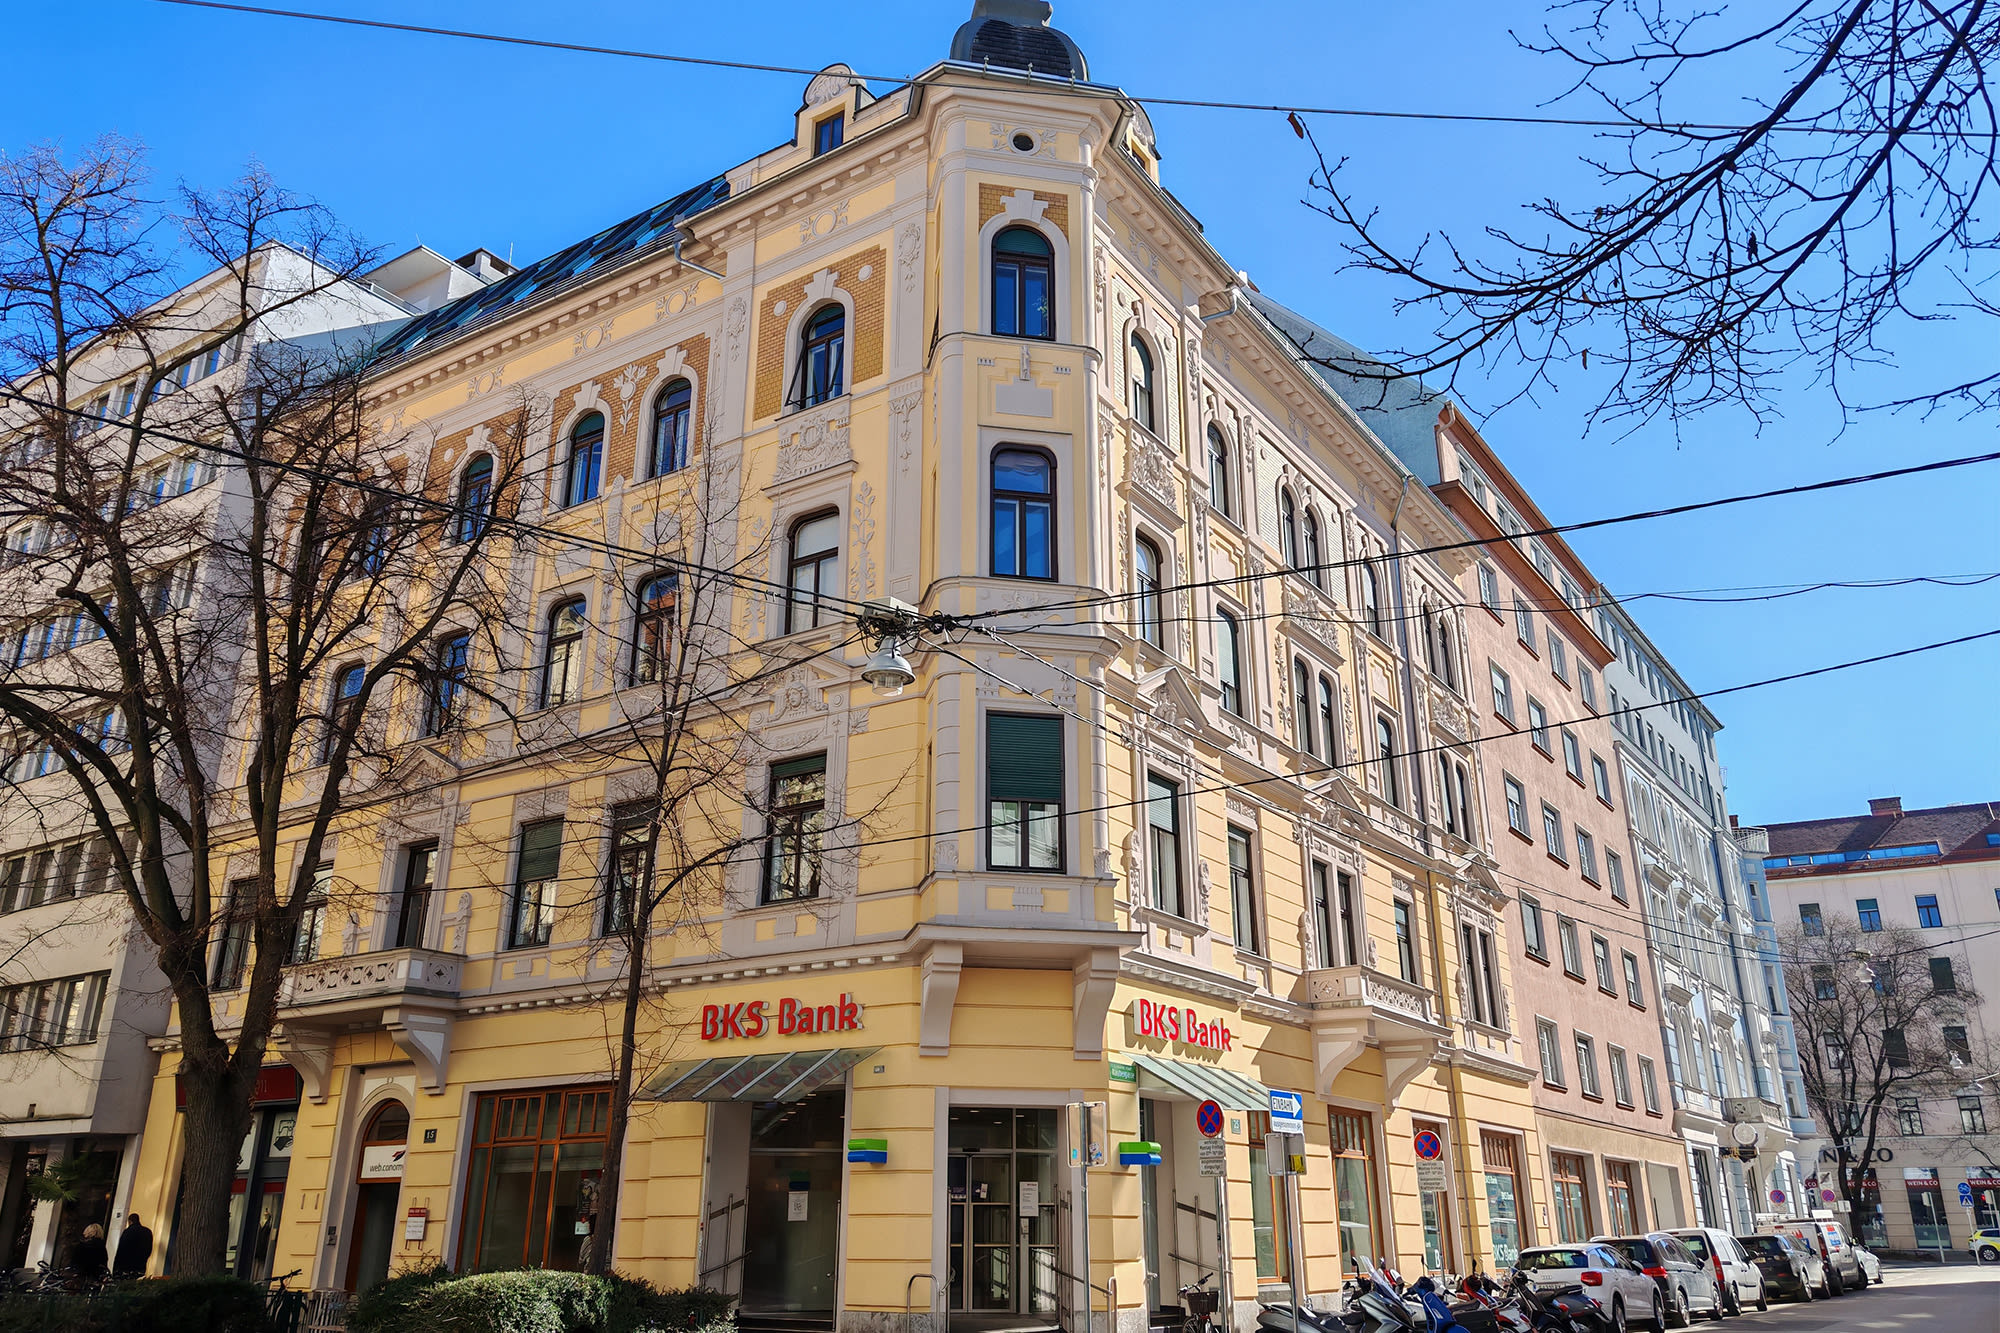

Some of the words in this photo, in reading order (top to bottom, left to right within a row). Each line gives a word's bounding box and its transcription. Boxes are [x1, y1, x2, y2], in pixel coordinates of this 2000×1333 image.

[701, 1001, 768, 1041] BKS
[778, 993, 862, 1034] Bank
[1137, 998, 1180, 1041] BKS
[1185, 1008, 1232, 1052] Bank
[1272, 1097, 1293, 1111] EINBAHN
[426, 1130, 435, 1139] 15
[1504, 1244, 1518, 1261] Bank
